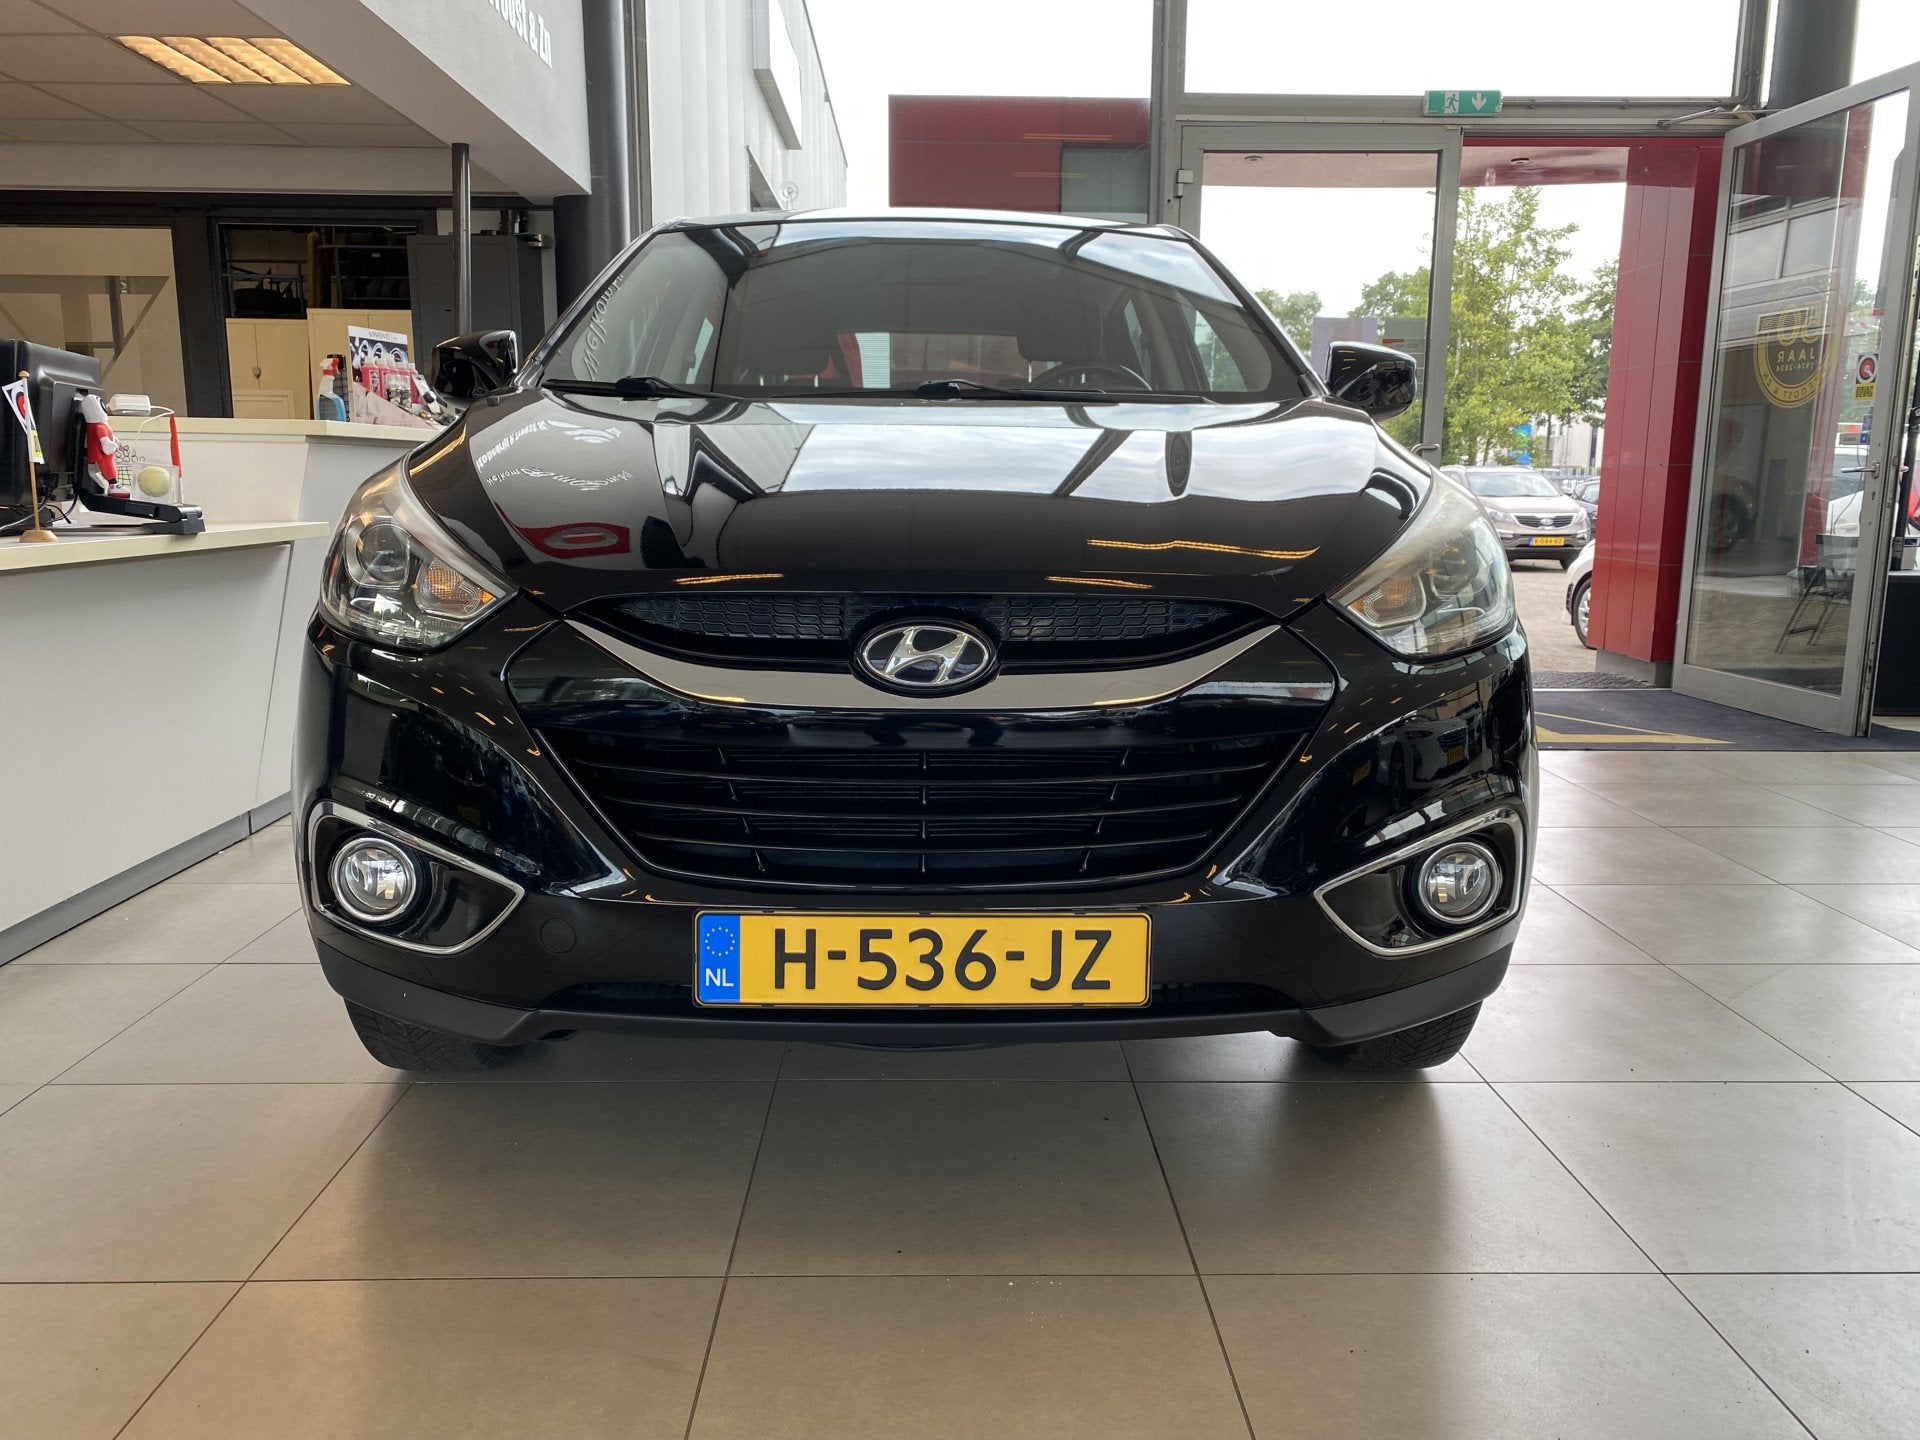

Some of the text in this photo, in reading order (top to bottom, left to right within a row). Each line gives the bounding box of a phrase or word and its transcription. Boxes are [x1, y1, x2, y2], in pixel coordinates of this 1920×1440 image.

[488, 0, 552, 70] oost & Zn
[705, 968, 735, 987] NL
[774, 928, 1112, 991] H-536-JZ
